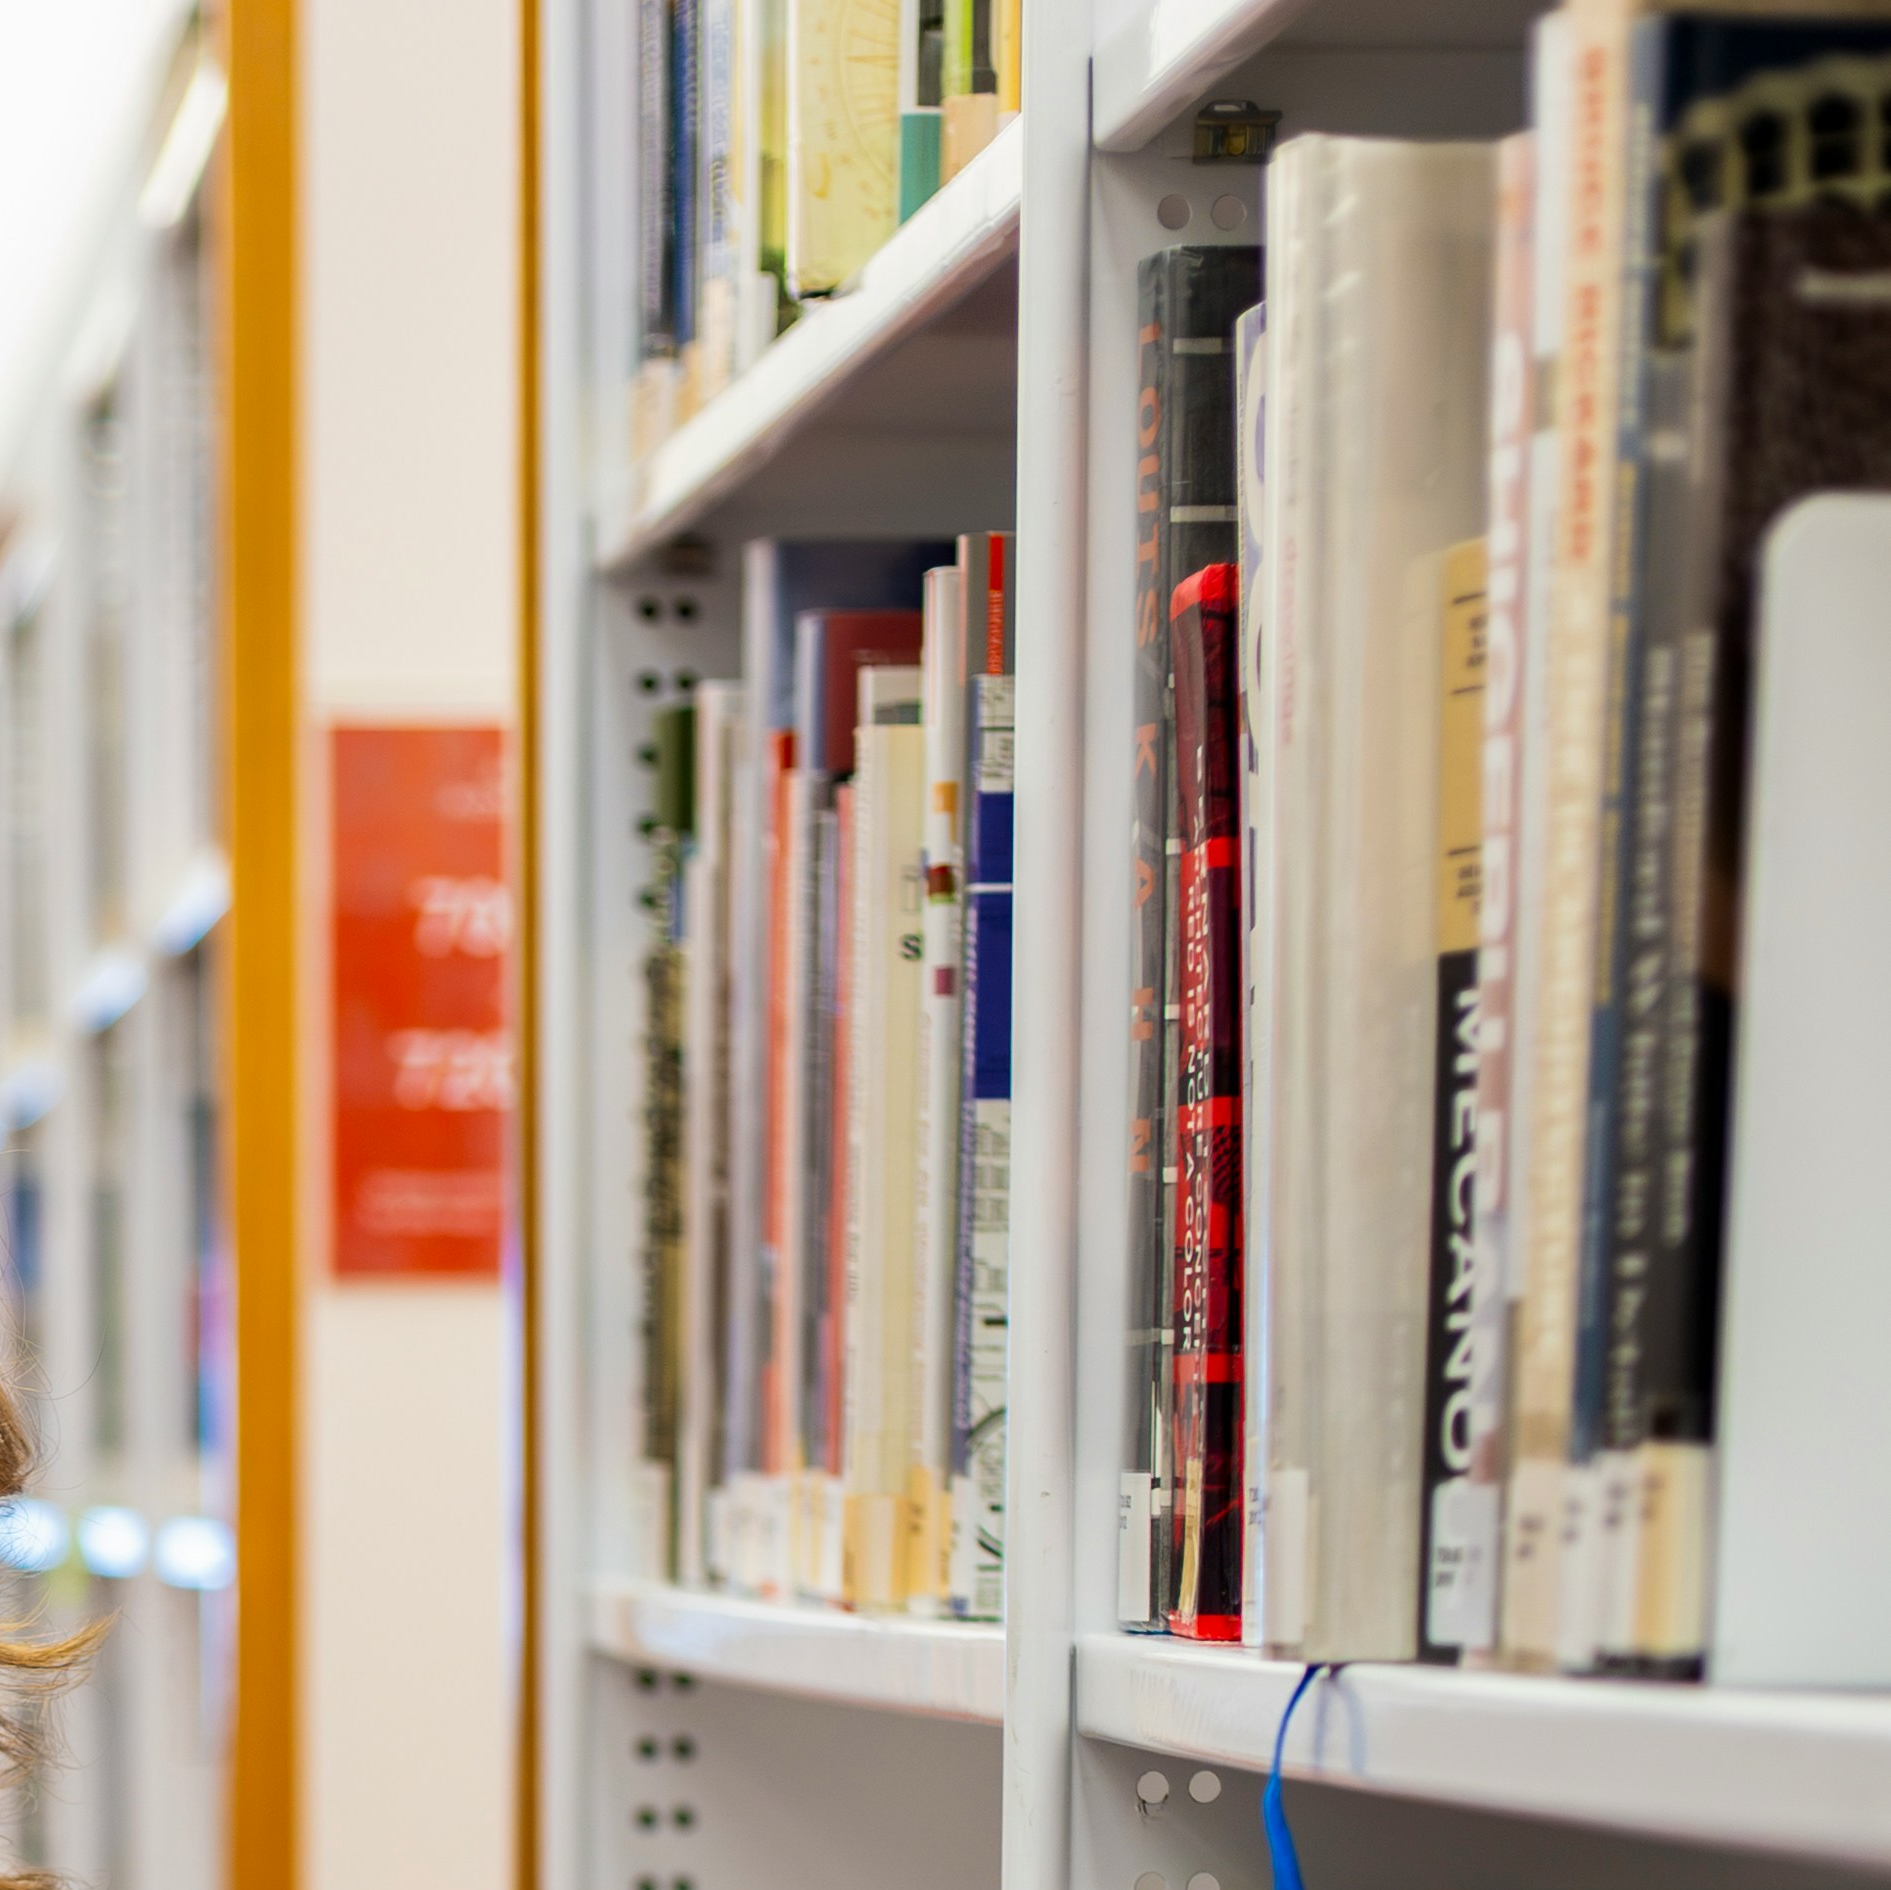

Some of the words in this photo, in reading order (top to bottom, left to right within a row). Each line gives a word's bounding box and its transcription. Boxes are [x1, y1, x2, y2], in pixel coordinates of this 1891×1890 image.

[1135, 322, 1163, 649] LOUIS
[1129, 722, 1157, 1173] KAHN
[1186, 886, 1196, 987] RED
[1193, 815, 1205, 1157] ARCHITECTURE
[1186, 991, 1195, 1028] IS
[1185, 1043, 1196, 1138] NOT
[1185, 1151, 1195, 1183] A
[1182, 1195, 1194, 1353] COLOR
